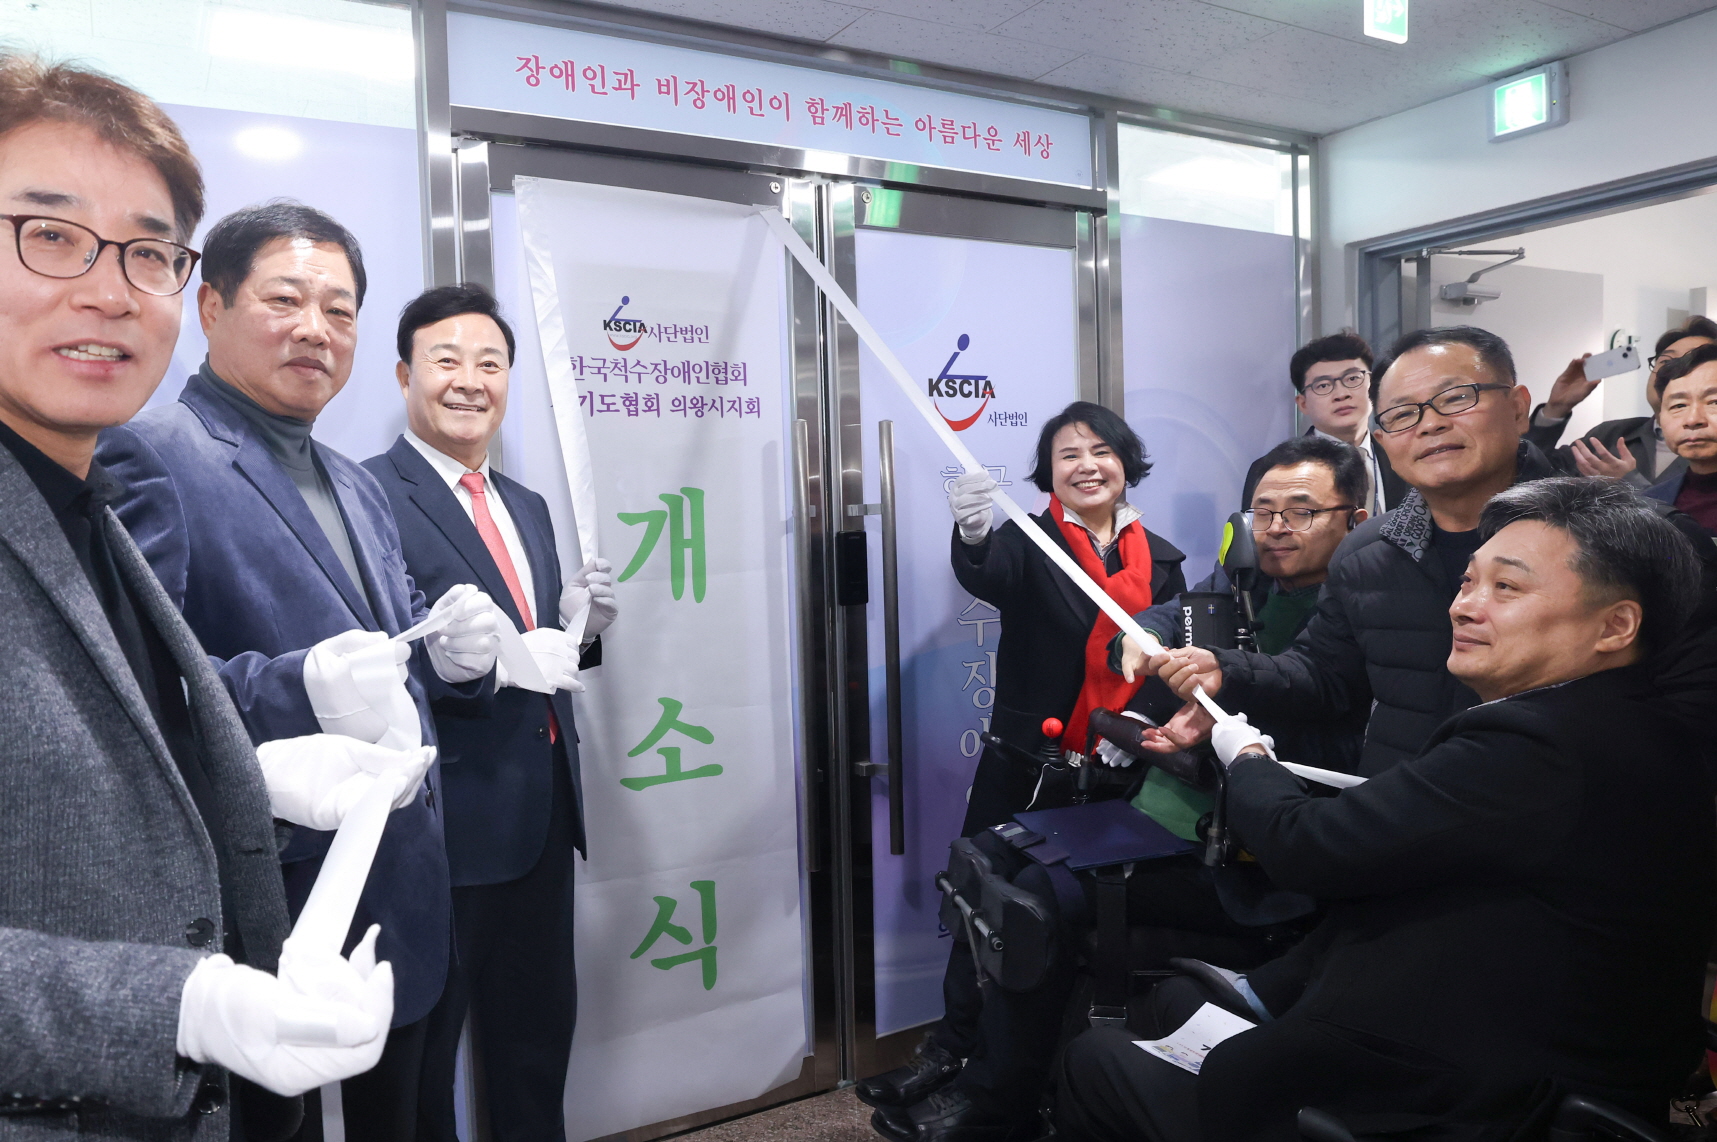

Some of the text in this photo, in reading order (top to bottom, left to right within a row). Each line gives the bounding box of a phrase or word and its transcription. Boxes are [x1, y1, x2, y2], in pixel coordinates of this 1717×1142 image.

[515, 54, 1054, 159] 장애인과 비장애인이 함께하는 아름다운 세상
[602, 319, 648, 334] KSCIA
[647, 323, 709, 344] 사단법인
[928, 377, 996, 399] KSCIA
[670, 395, 761, 419] 의왕시지회
[987, 411, 1028, 427] 사단법인
